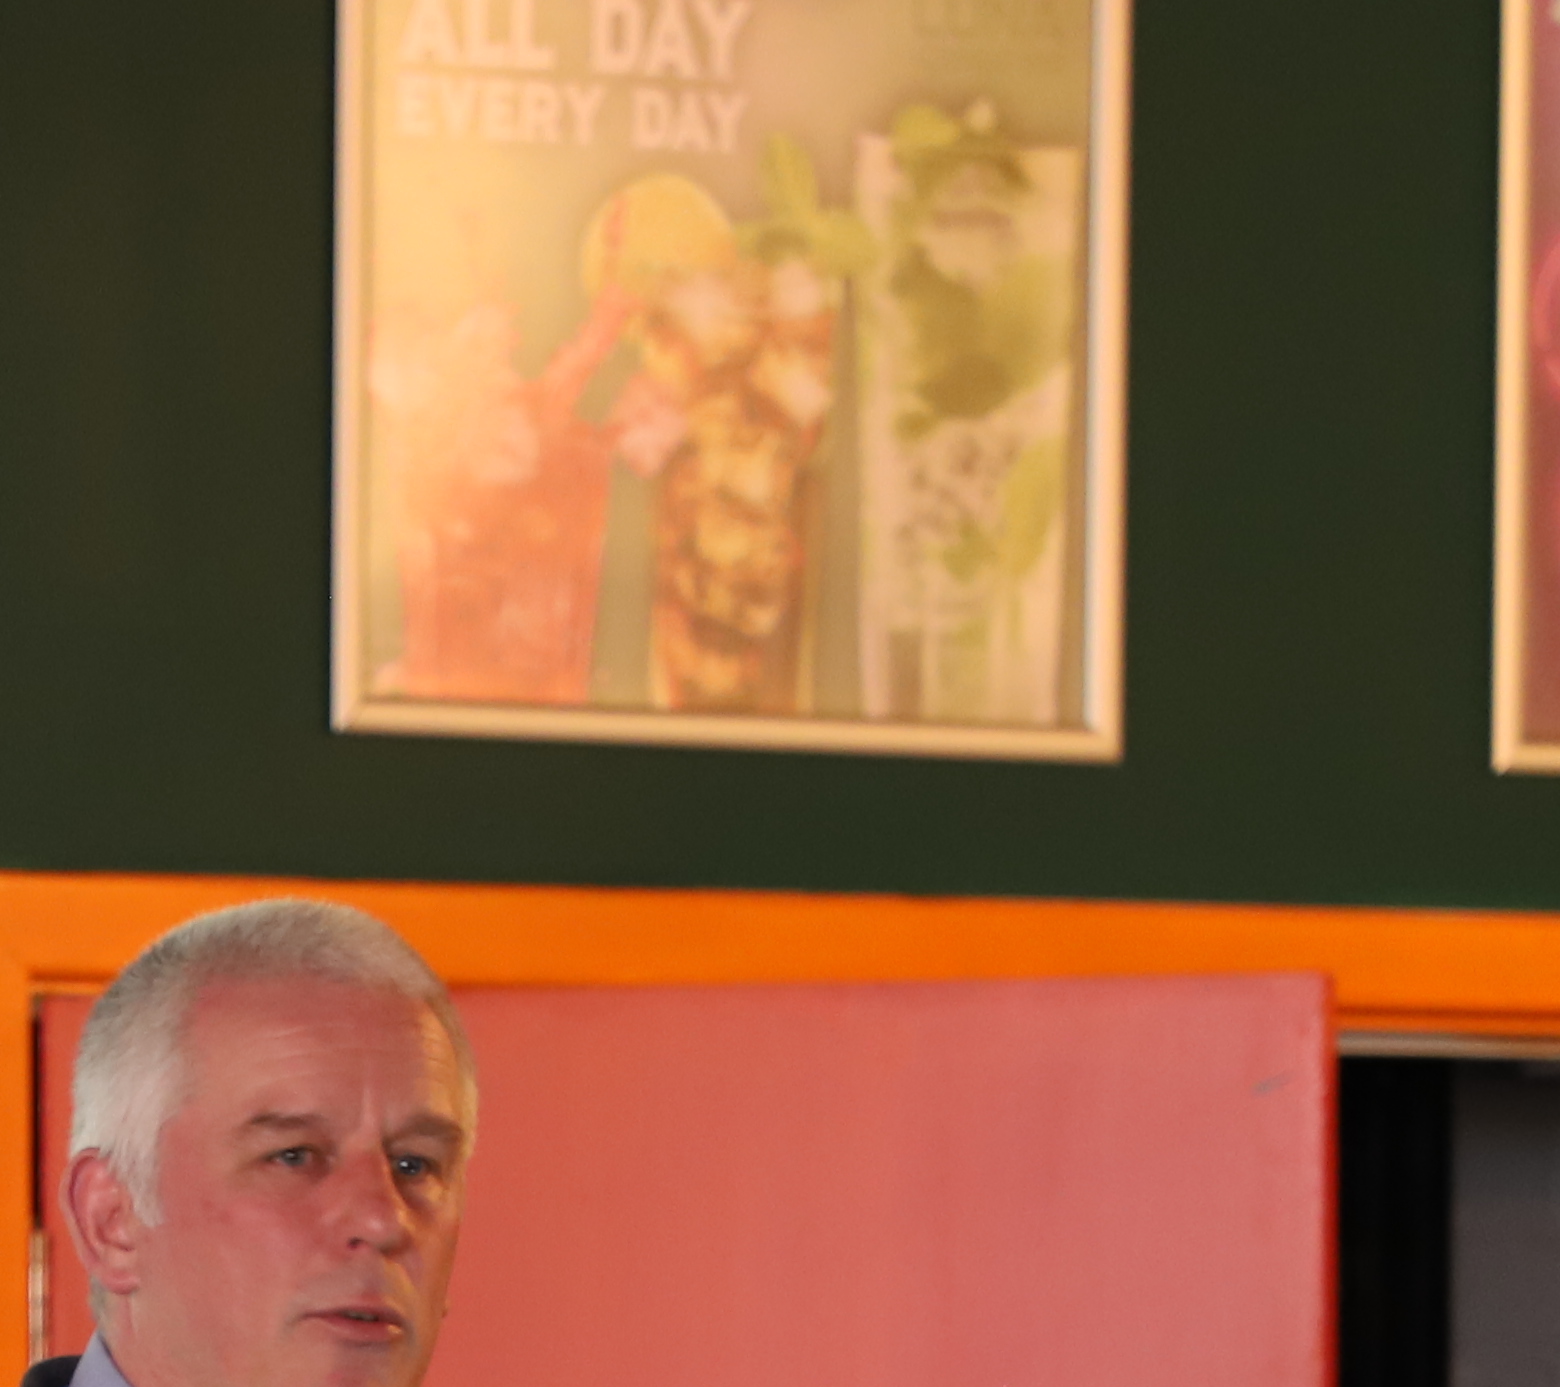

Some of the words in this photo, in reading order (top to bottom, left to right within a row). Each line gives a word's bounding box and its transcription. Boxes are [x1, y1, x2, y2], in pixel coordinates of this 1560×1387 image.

[398, 0, 556, 70] ALL
[588, 0, 751, 80] DAY
[395, 70, 607, 146] EVERY
[631, 86, 750, 153] DAY
